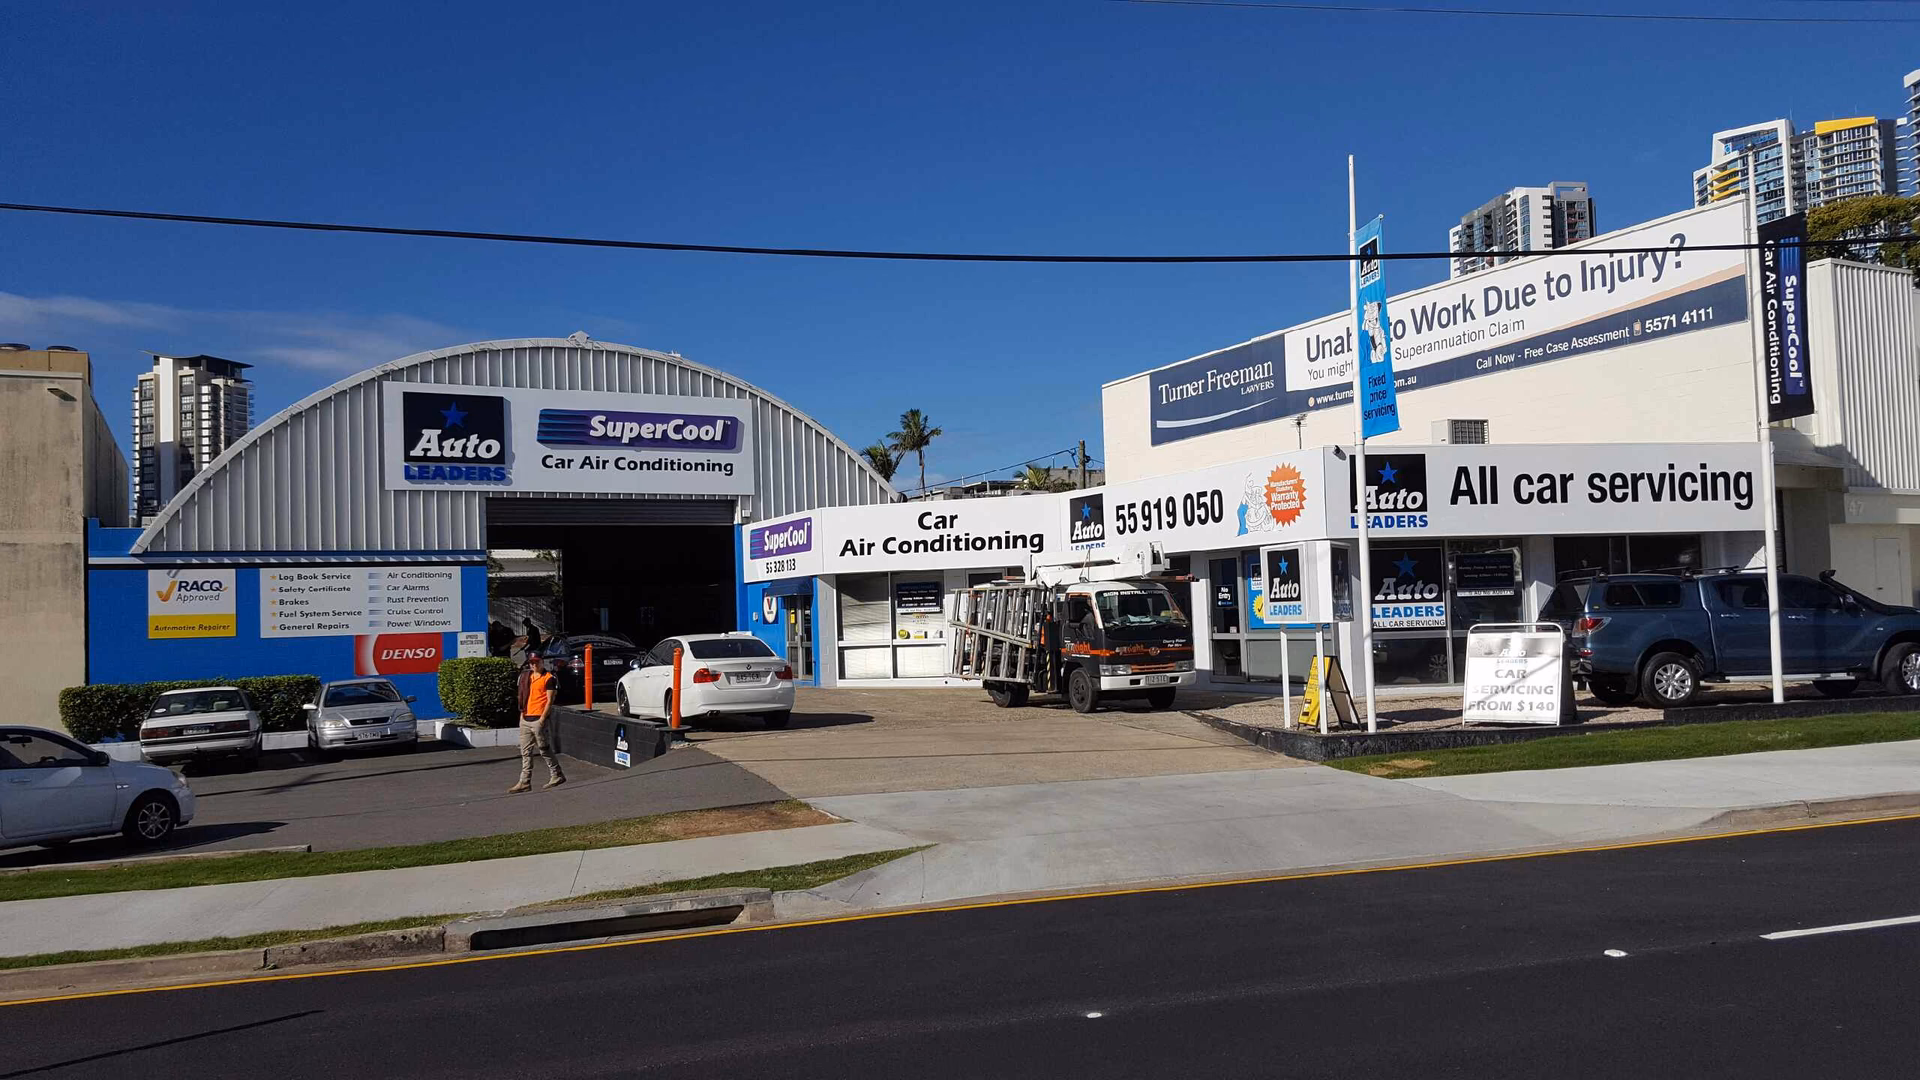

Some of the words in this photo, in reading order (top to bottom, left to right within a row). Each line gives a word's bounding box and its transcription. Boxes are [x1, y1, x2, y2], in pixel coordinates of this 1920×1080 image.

[1410, 294, 1476, 335] Work
[1484, 283, 1536, 316] Due
[1544, 271, 1572, 301] to
[1581, 233, 1686, 294] Injury?
[1765, 271, 1777, 294] Air
[1476, 356, 1492, 370] Call
[1495, 353, 1515, 366] Now
[1525, 347, 1543, 360] Free
[1546, 343, 1569, 355] Case
[1571, 326, 1630, 349] Assessment
[1645, 313, 1677, 333] 5571
[1681, 307, 1714, 325] 4111
[1308, 369, 1325, 381] You
[1394, 328, 1485, 360] Superannuation
[1489, 319, 1525, 338] Claim
[1767, 299, 1782, 405] Conditioning
[1158, 378, 1205, 405] Turner
[1206, 360, 1274, 393] Freeman
[1241, 380, 1275, 395] LAWYERS
[1368, 372, 1386, 389] Fixed
[1369, 387, 1387, 404] price
[1363, 402, 1396, 422] servicing
[409, 428, 501, 460] Auto
[404, 464, 507, 482] LEADERS
[541, 455, 574, 470] Car
[579, 455, 609, 471] Air
[613, 456, 734, 476] Conditioning
[1450, 465, 1498, 506] All
[1513, 470, 1575, 505] car
[1587, 463, 1754, 511] servicing
[1271, 491, 1299, 501] Warranty
[1116, 503, 1138, 535] 55
[1141, 496, 1177, 532] 919
[1183, 489, 1224, 527] 050
[1271, 501, 1300, 510] Protected
[918, 511, 959, 531] Car
[1351, 514, 1429, 529] LADERS
[1072, 521, 1103, 541] Auto
[839, 539, 875, 557] Air
[882, 531, 1044, 554] Conditioning
[774, 560, 785, 573] 328
[278, 574, 294, 582] Log
[401, 571, 452, 580] Conditioning
[177, 580, 223, 591] RACQ
[1269, 577, 1300, 599] Auto
[1375, 577, 1439, 601] Auto
[176, 593, 220, 603] Approved
[407, 595, 449, 603] Prevention
[299, 610, 330, 618] System
[331, 609, 362, 617] Service
[1269, 604, 1302, 616] LEADERS
[1371, 605, 1445, 619] LEADERS
[279, 623, 316, 631] General
[387, 620, 411, 628] Power
[414, 619, 451, 627] Windows
[1389, 620, 1404, 628] CAR
[1406, 619, 1445, 627] SERVICING
[381, 647, 436, 660] DENSO
[1499, 649, 1526, 657] Ao
[1495, 669, 1527, 679] CAR
[1472, 685, 1554, 695] SERVICING
[1467, 701, 1512, 711] FROM
[1517, 700, 1555, 712] $140
